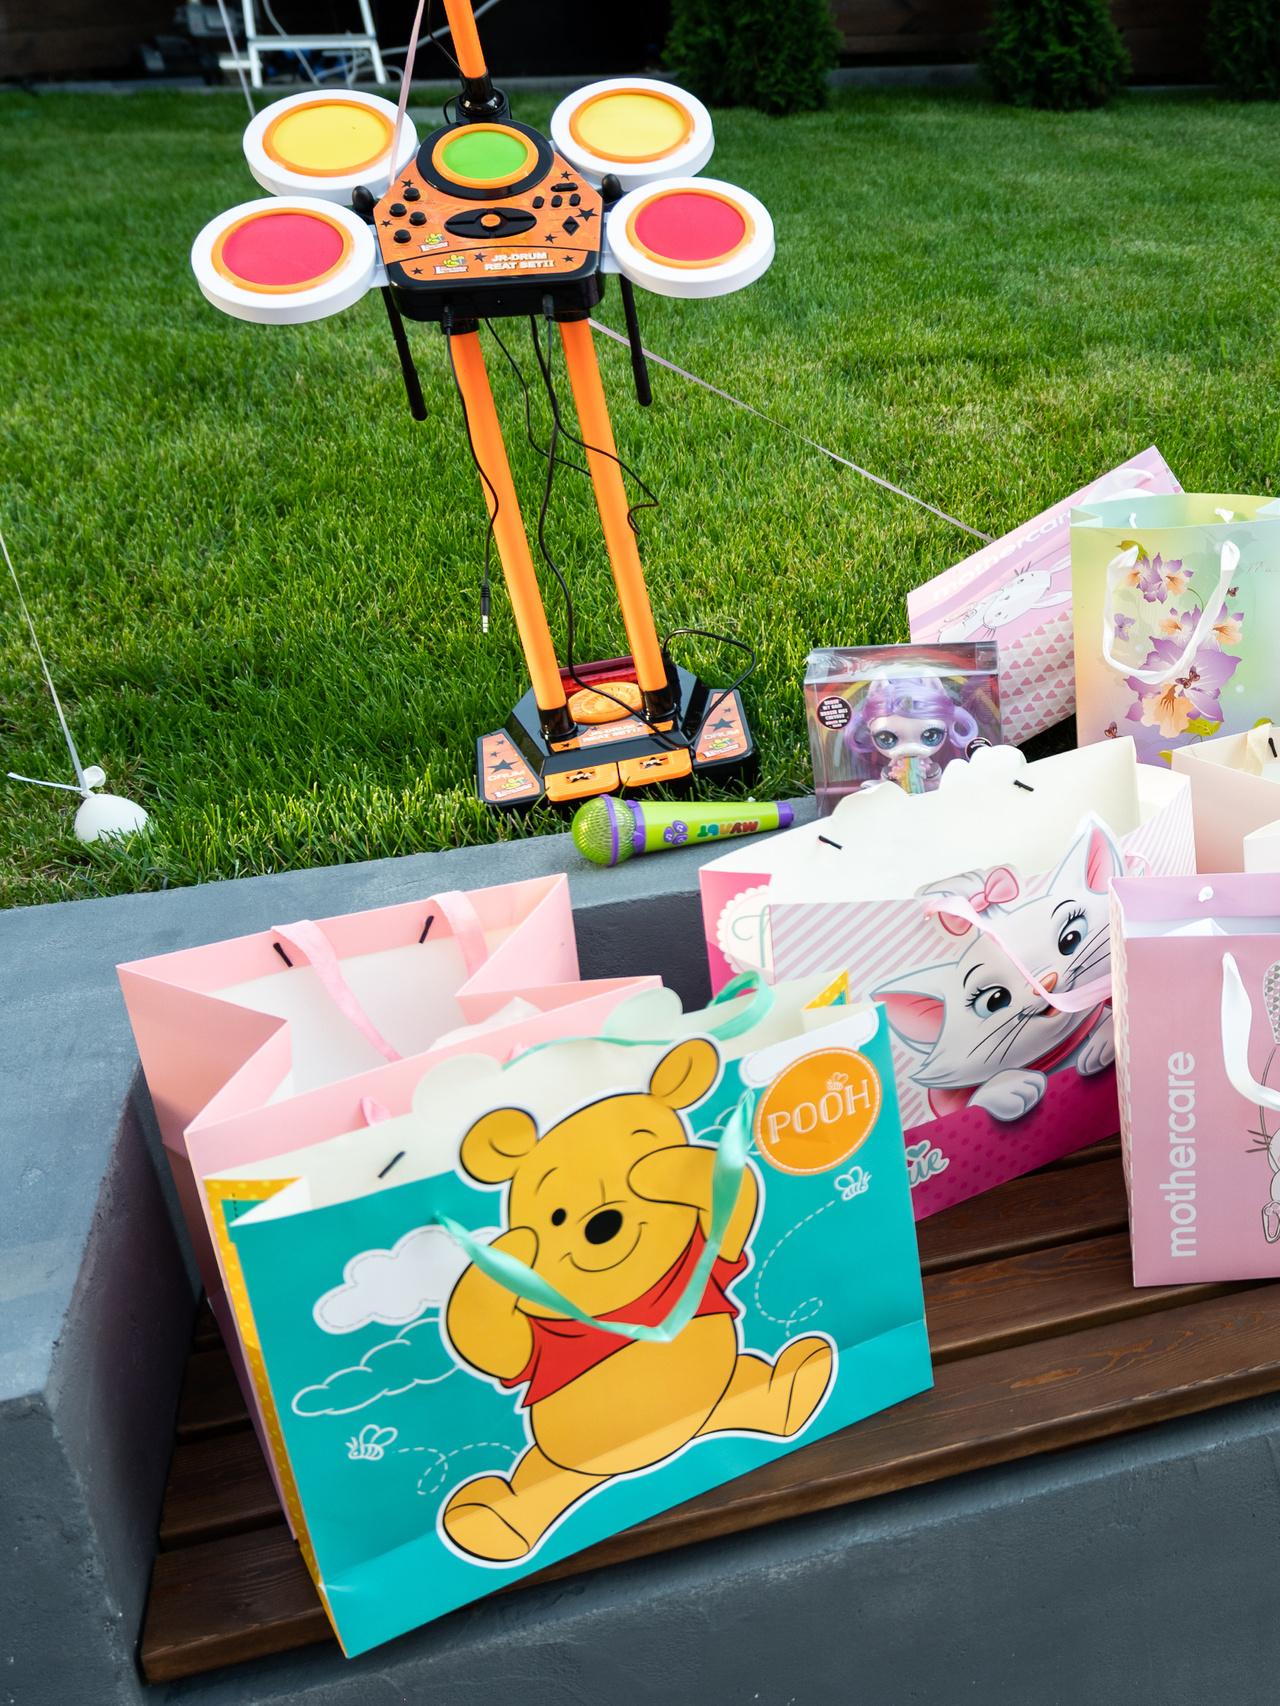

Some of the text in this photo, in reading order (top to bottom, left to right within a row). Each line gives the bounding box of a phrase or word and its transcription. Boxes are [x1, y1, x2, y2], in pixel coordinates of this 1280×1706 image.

[491, 252, 548, 262] JR-DRUM
[703, 729, 740, 740] DRUM
[487, 770, 526, 782] DRUM
[696, 821, 760, 838] МУЛЬТ
[767, 1079, 871, 1145] POOH
[1159, 1051, 1197, 1257] mothercare
